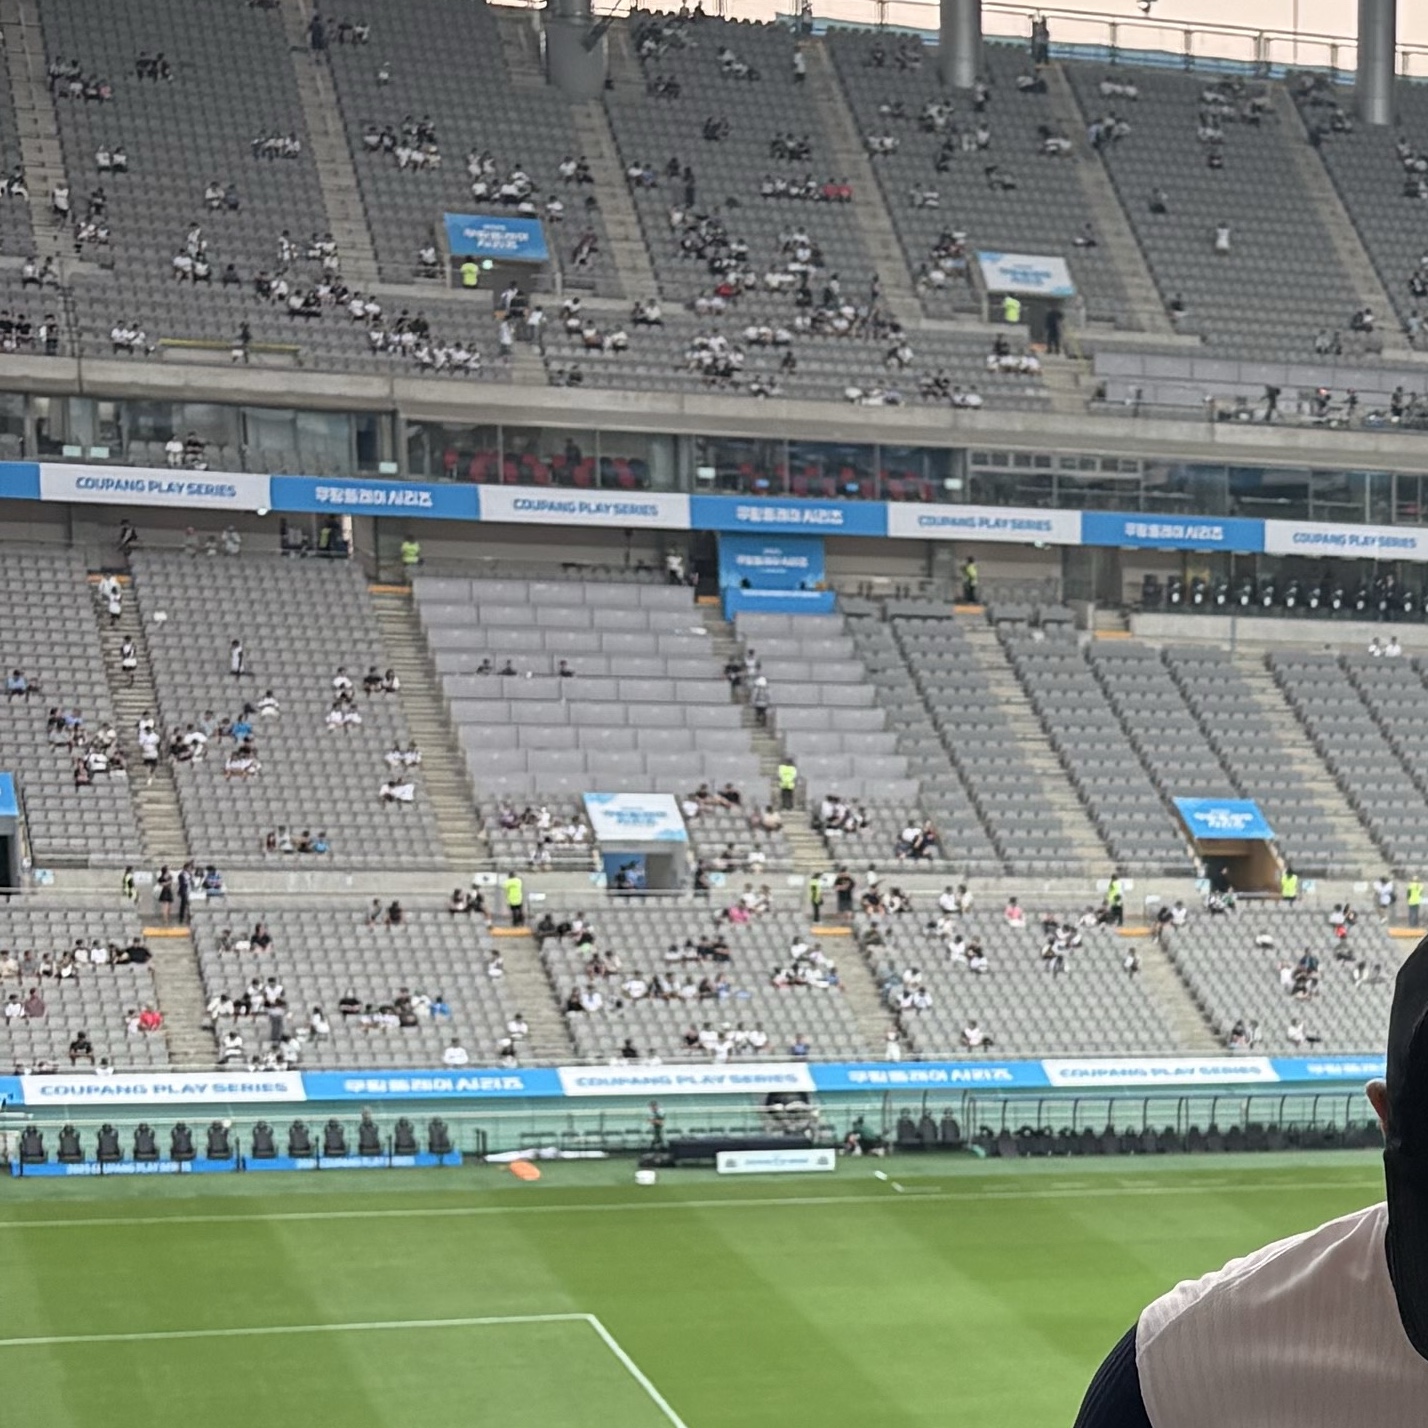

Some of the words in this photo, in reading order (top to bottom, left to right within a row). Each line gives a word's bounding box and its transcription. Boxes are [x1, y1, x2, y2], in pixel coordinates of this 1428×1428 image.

[76, 476, 147, 493] COUPANG
[149, 479, 184, 495] PLAY
[187, 482, 237, 498] SERIES
[513, 498, 576, 513] COUPANG
[578, 501, 613, 514] PLAY
[616, 504, 658, 517] SERIES
[40, 1084, 148, 1096] COUPANG
[153, 1083, 207, 1095] PLAY
[212, 1082, 287, 1094] SERIES
